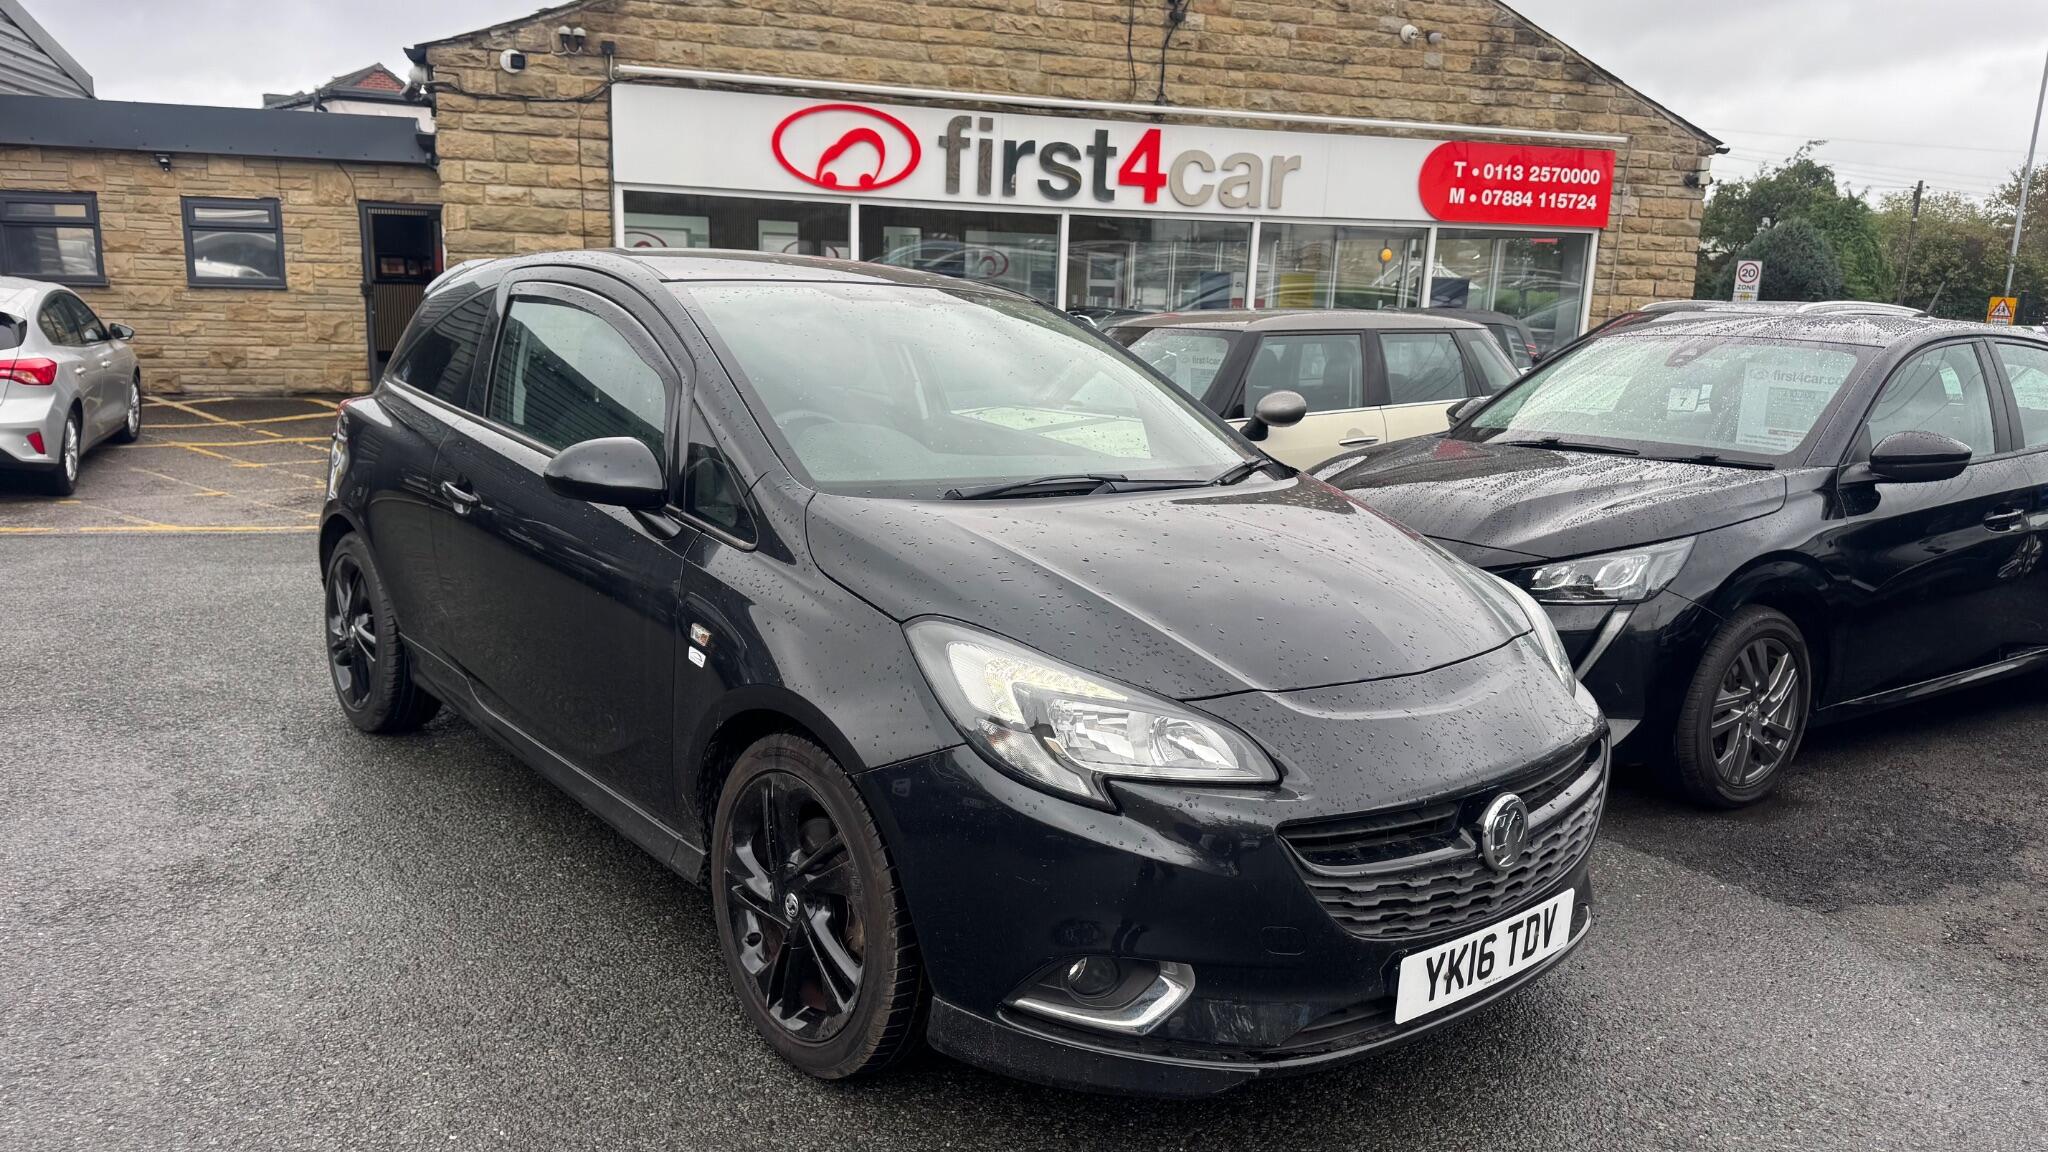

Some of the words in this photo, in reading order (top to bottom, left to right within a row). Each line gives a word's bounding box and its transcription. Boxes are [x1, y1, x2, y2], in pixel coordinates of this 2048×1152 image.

[938, 115, 1301, 209] first4car
[1454, 161, 1467, 178] T
[1483, 163, 1524, 182] 0113
[1528, 165, 1601, 186] 2570000
[1449, 187, 1465, 205] M
[1481, 189, 1533, 208] 07884
[1537, 192, 1597, 211] 115724
[1741, 268, 1756, 278] 20
[1425, 932, 1498, 1002] YK16
[1507, 902, 1560, 967] TDV
